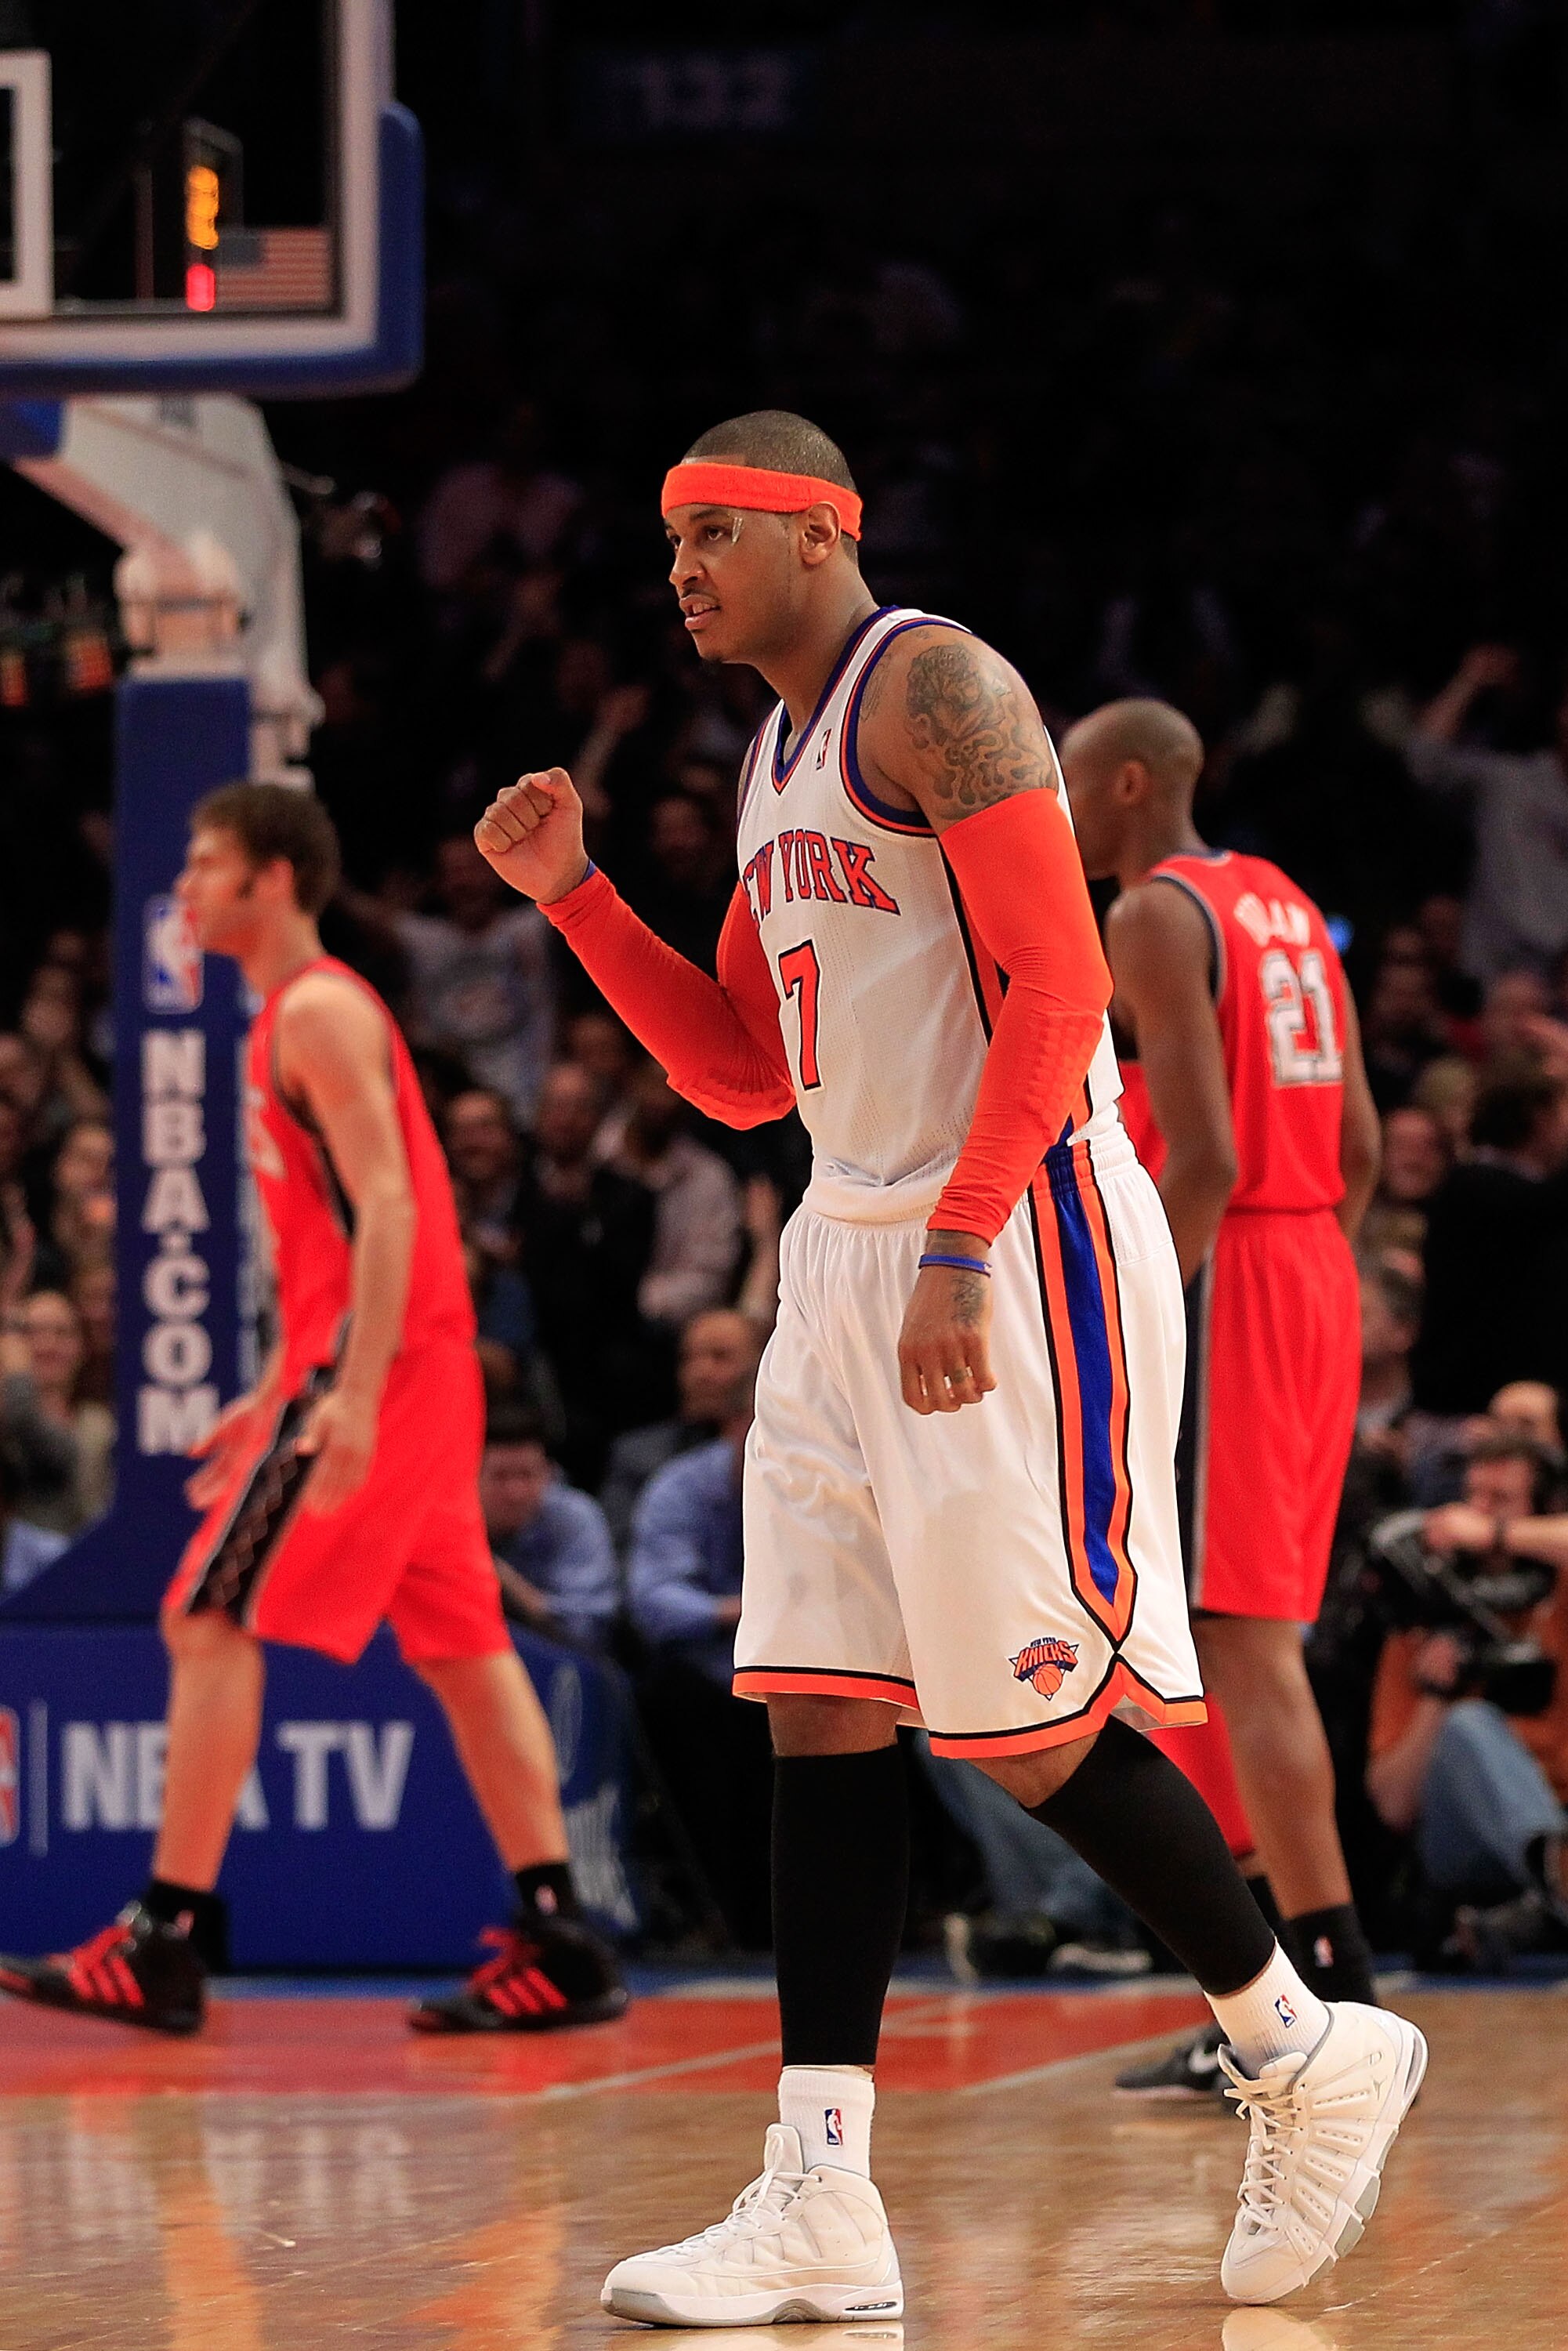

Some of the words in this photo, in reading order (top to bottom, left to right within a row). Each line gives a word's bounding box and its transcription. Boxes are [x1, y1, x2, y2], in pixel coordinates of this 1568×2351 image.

[778, 828, 901, 916] YORK
[779, 940, 822, 1091] 7
[1262, 951, 1342, 1085] 21
[1014, 1640, 1078, 1678] KNICKS
[276, 1721, 416, 1831] TV
